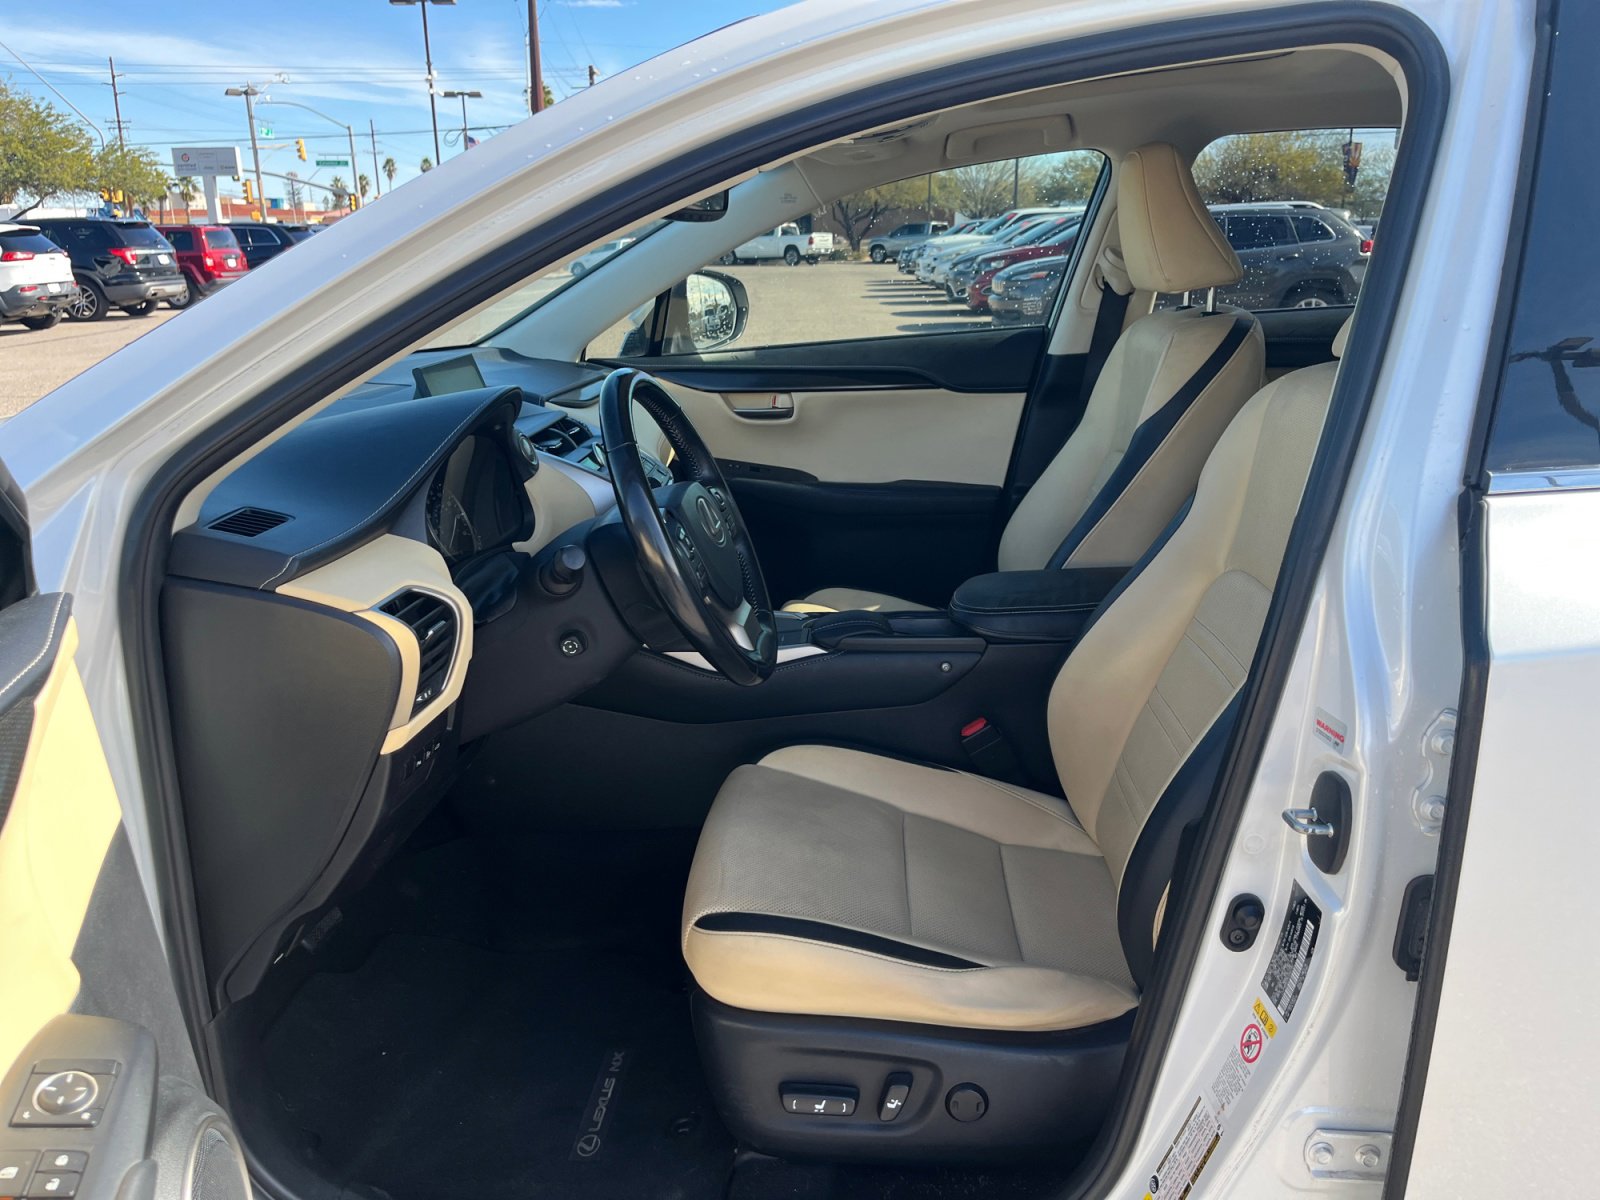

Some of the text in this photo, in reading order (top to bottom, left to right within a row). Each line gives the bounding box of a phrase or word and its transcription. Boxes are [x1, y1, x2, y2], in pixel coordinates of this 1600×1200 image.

[1316, 718, 1345, 744] WARNING
[588, 1051, 625, 1132] LEXUS NX
